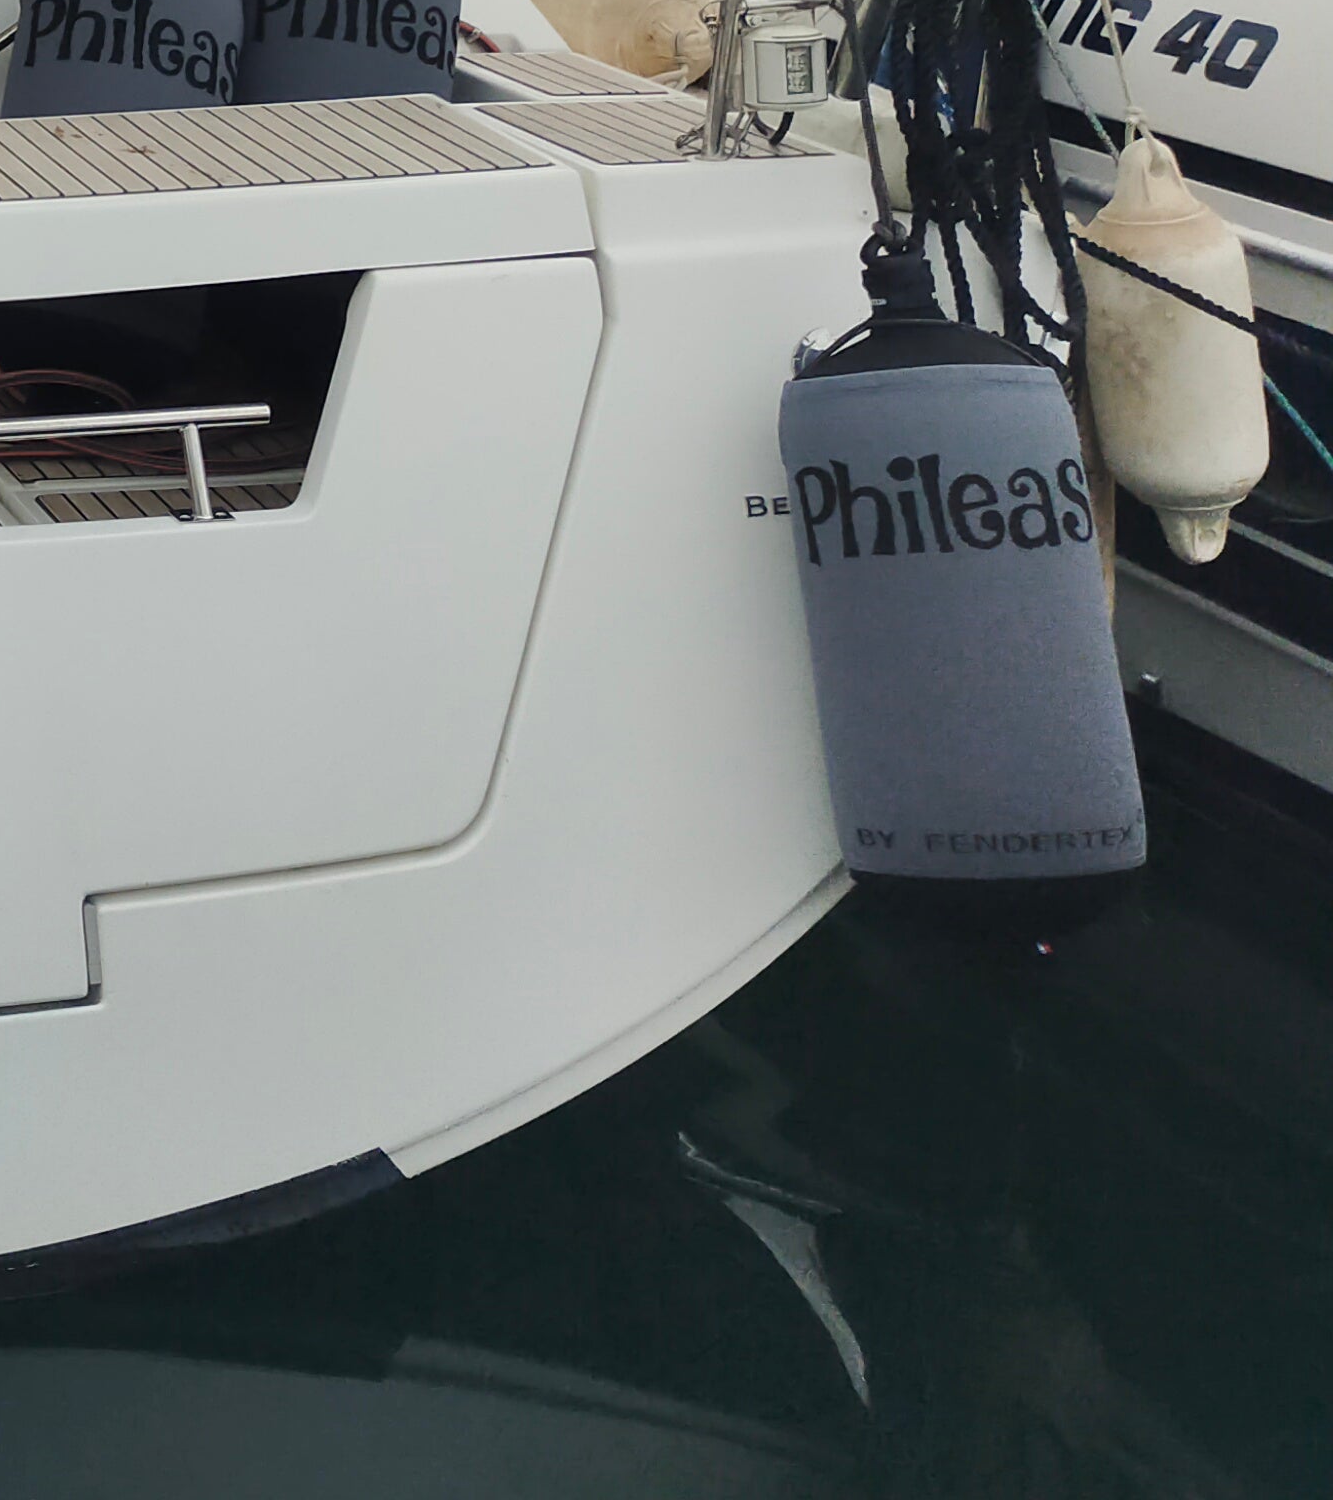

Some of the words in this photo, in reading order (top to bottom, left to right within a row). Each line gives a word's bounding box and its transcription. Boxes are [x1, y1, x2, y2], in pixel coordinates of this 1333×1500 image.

[1153, 9, 1279, 90] 40
[794, 454, 1094, 568] Phileas
[856, 827, 896, 850] BY
[925, 824, 1132, 854] FENDERTEX
